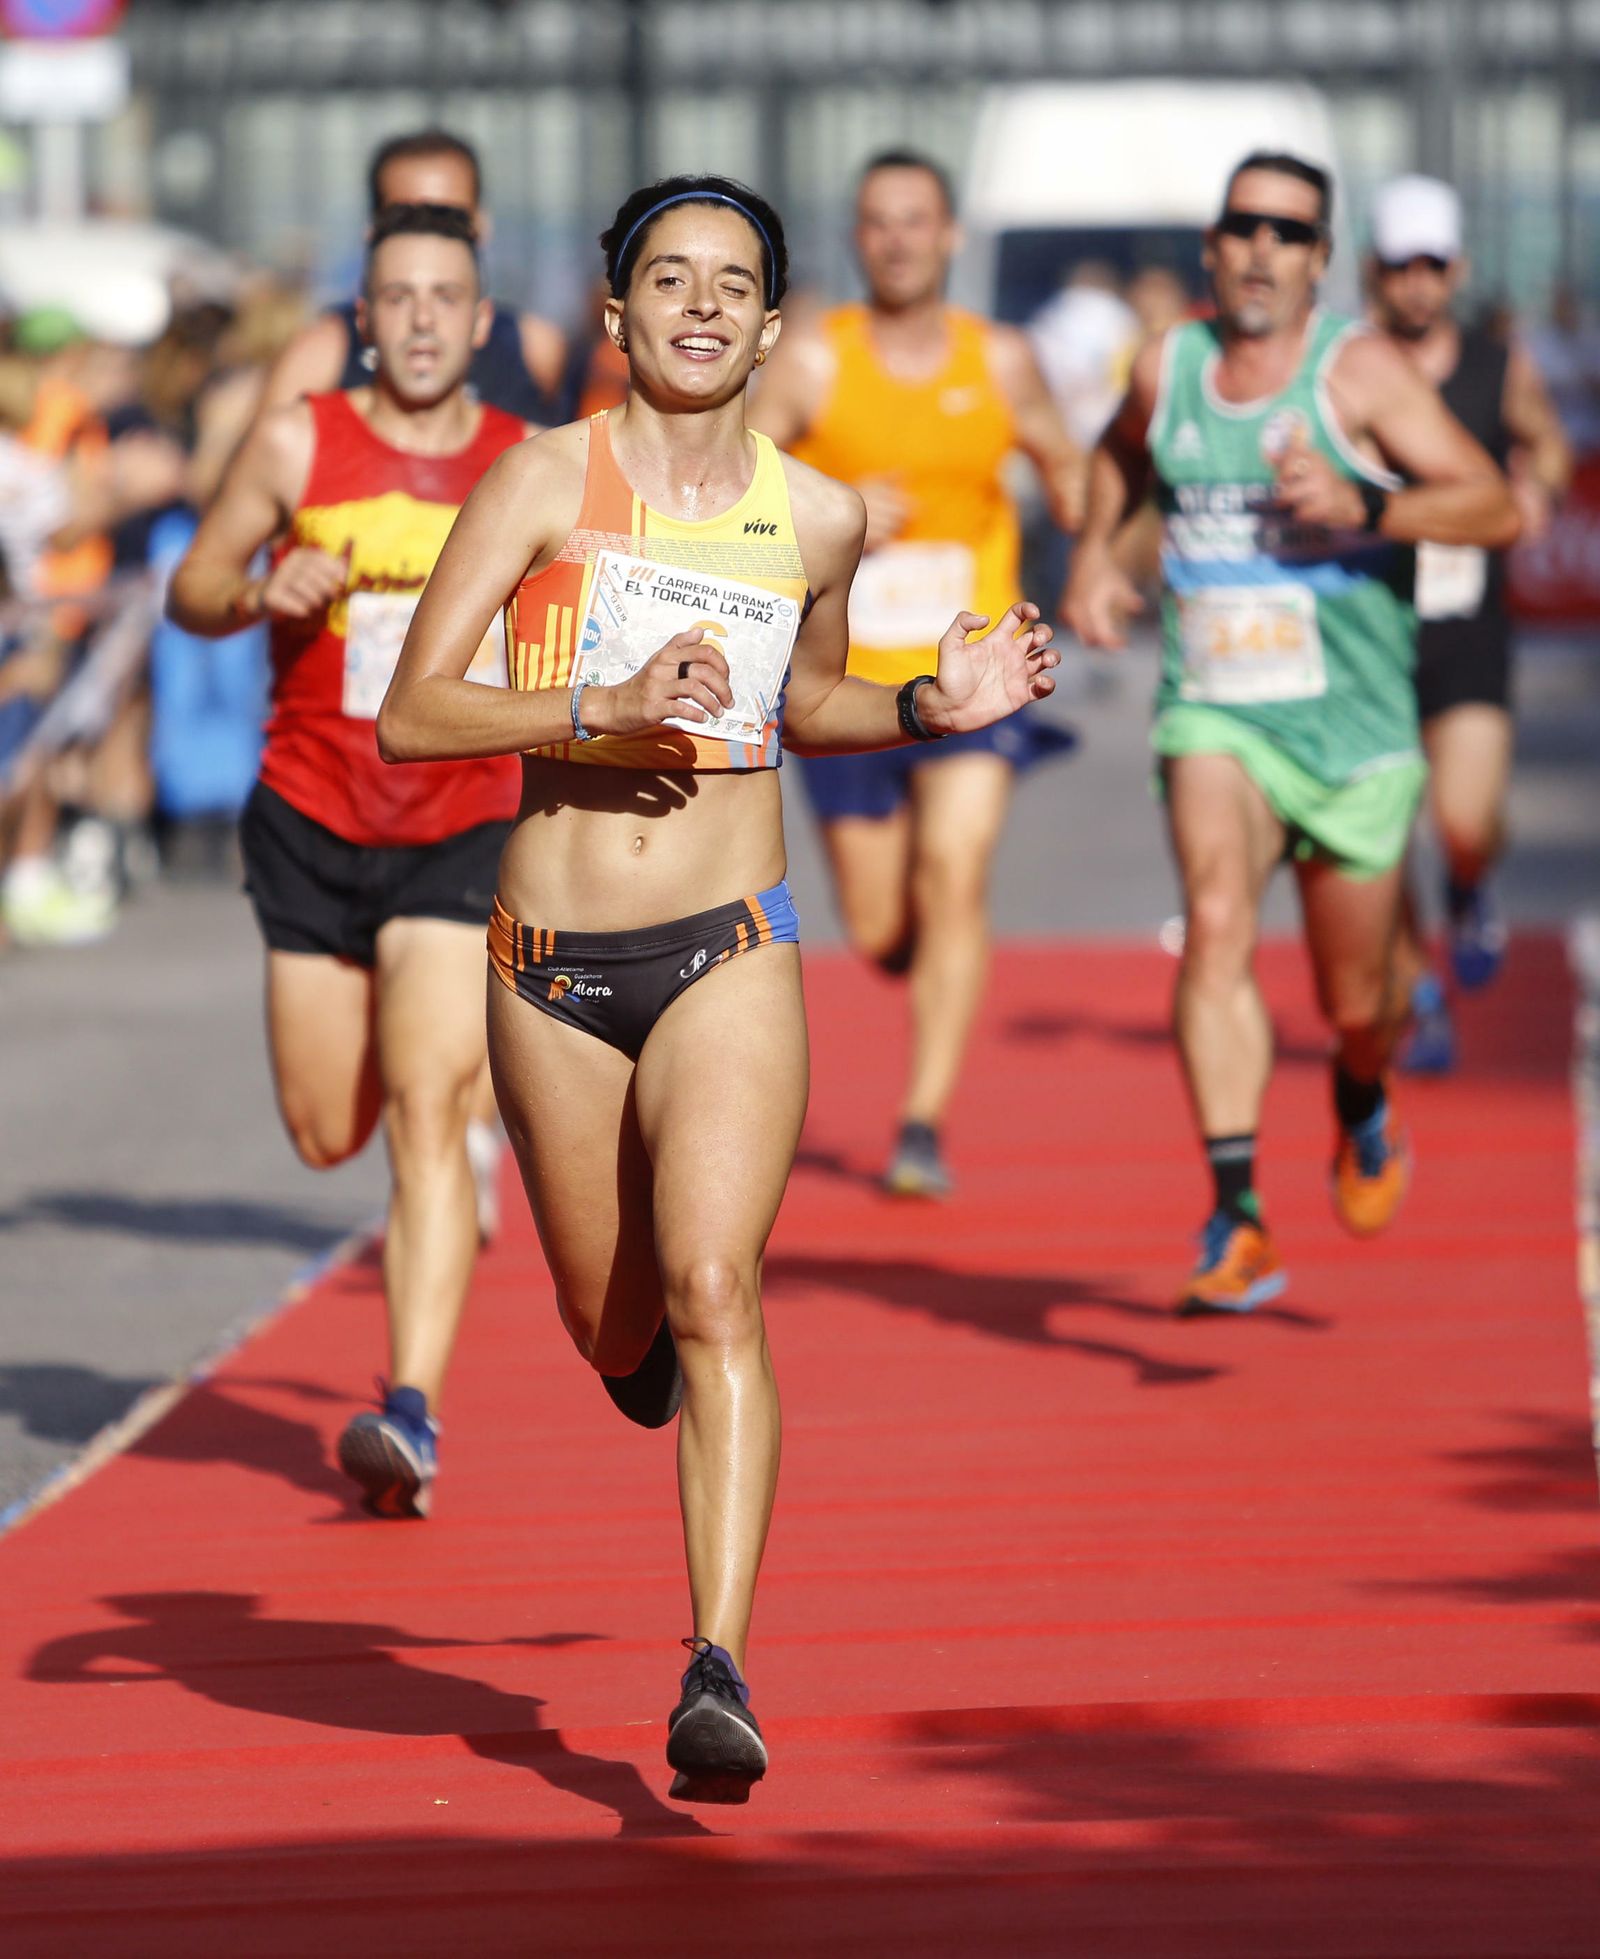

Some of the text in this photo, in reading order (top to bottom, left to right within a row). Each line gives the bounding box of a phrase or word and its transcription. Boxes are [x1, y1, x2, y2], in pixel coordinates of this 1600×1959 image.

[625, 580, 643, 595] EL
[650, 586, 711, 611] TORCAL
[719, 602, 739, 617] LA
[744, 608, 774, 624] PAZ
[658, 575, 718, 598] CARRERA
[722, 590, 774, 611] URBANA
[572, 980, 613, 997] Álora
